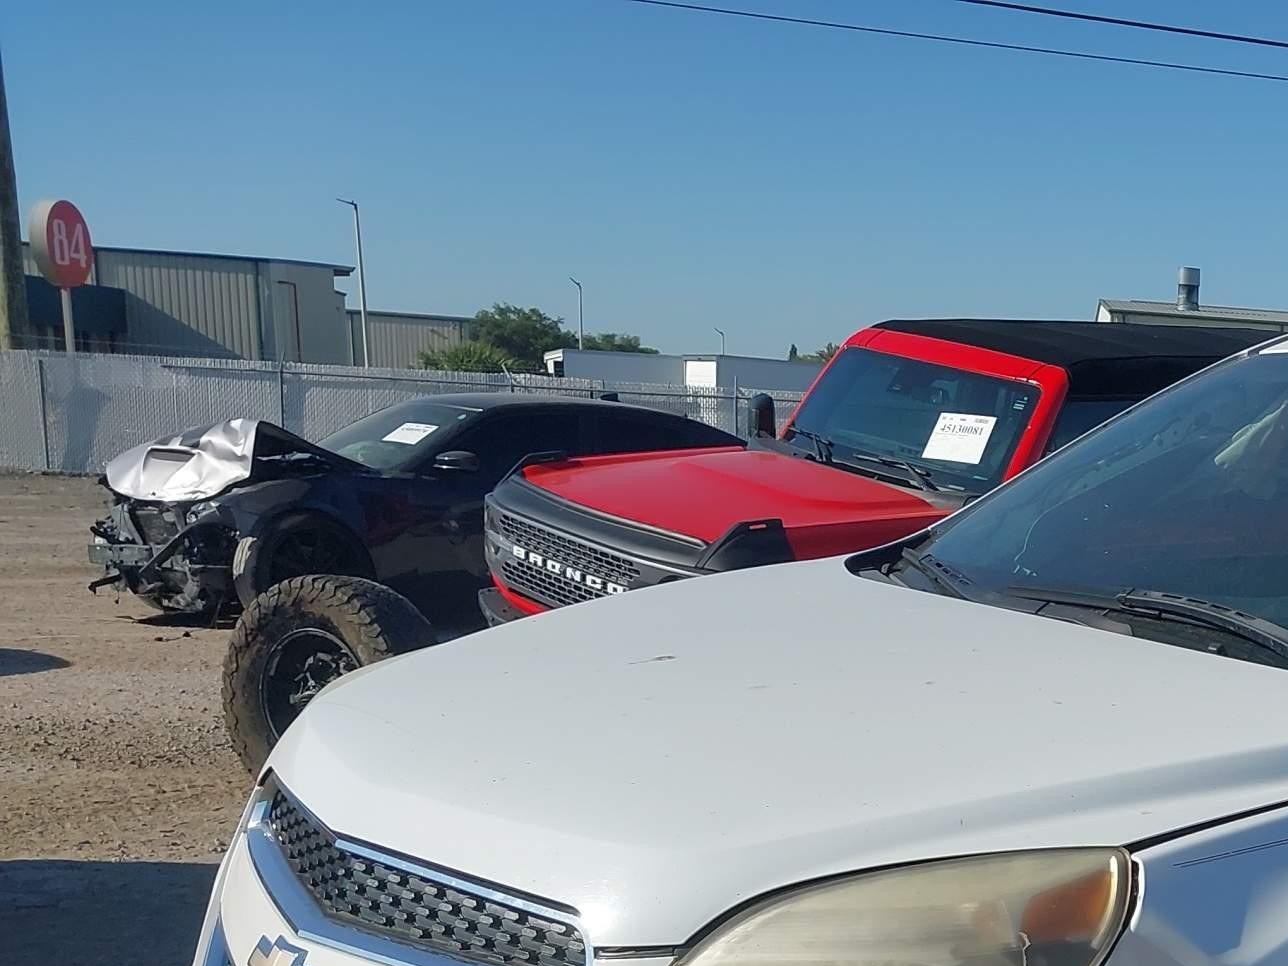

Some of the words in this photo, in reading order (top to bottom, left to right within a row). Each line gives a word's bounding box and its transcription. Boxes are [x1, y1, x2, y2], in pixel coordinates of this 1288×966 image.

[52, 218, 87, 268] 84
[939, 423, 985, 436] 45130081
[511, 545, 630, 595] BRONCO
